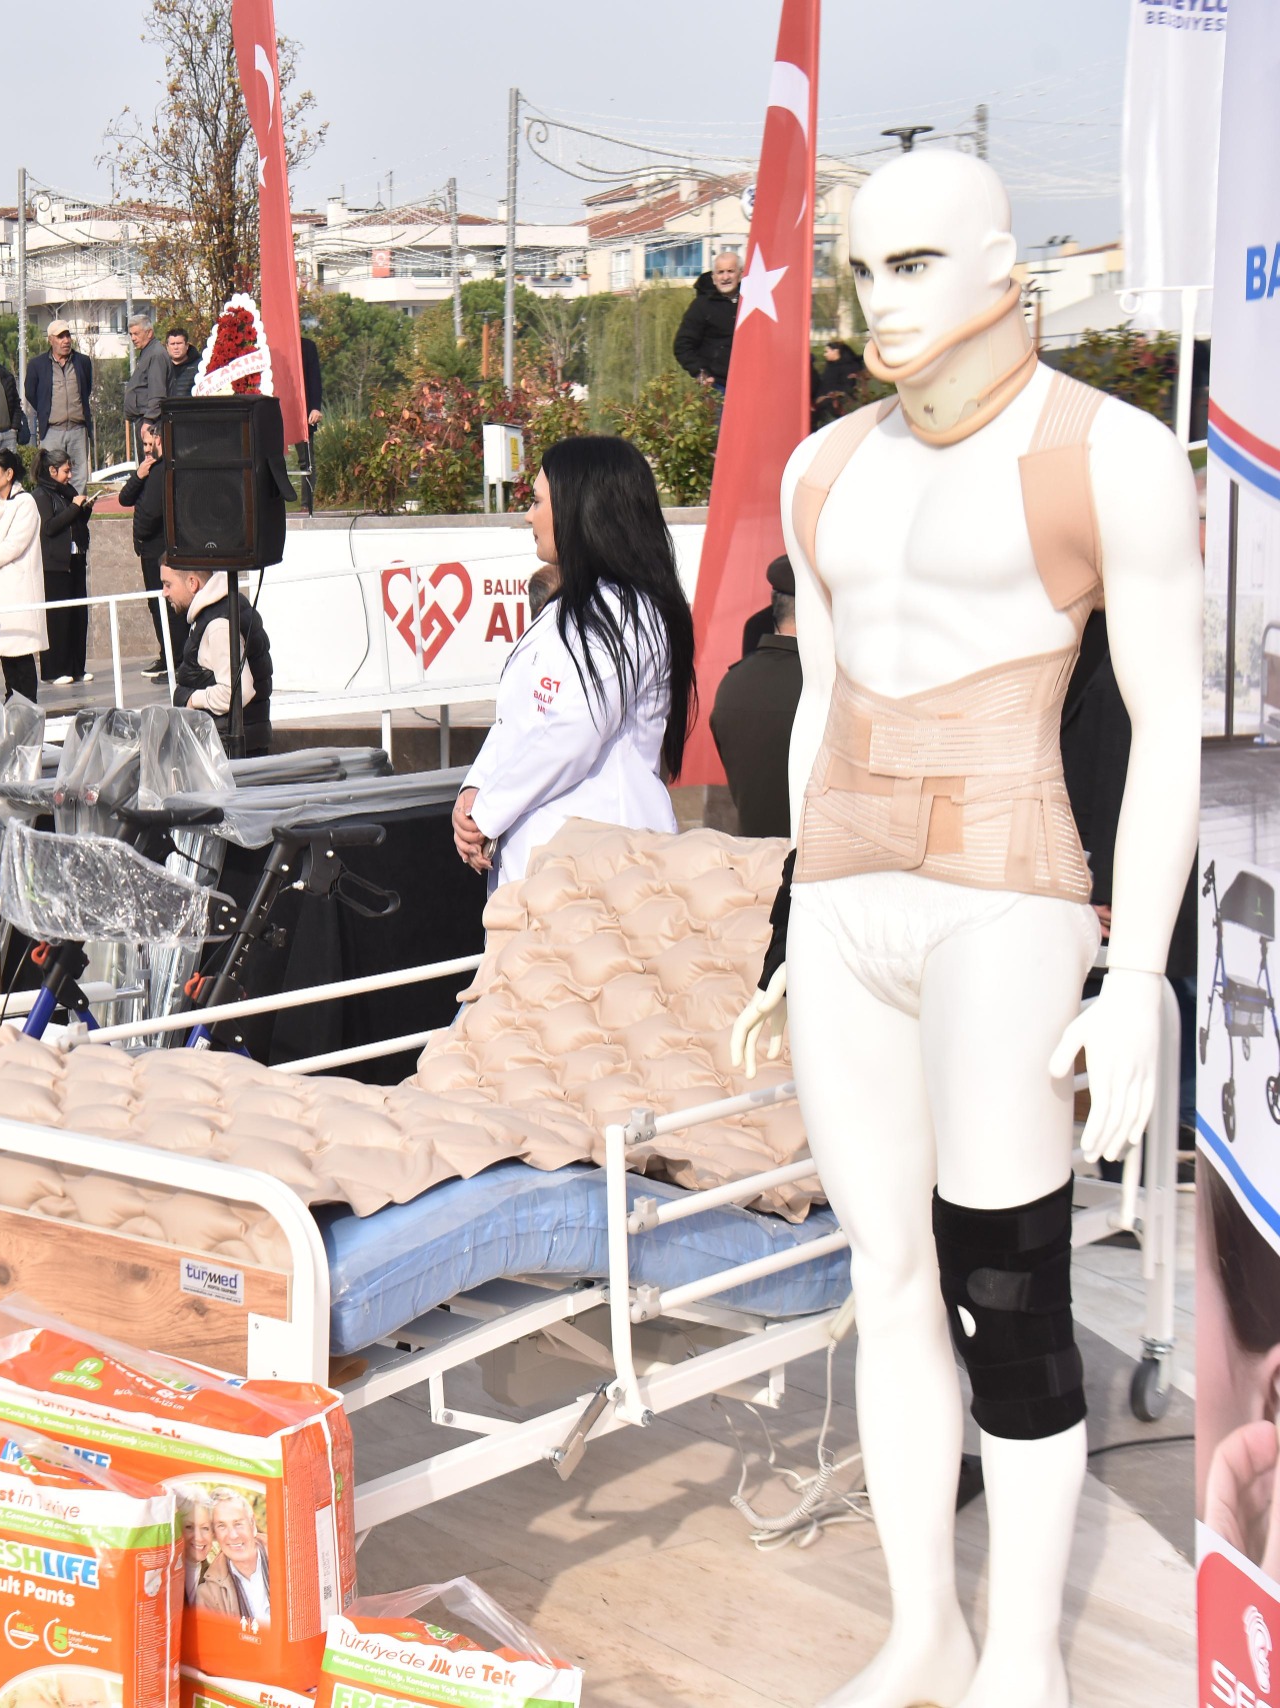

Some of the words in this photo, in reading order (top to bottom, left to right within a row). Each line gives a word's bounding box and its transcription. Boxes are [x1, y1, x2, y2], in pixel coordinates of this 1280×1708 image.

[484, 579, 528, 596] BALIK
[17, 1491, 33, 1507] in
[23, 1582, 76, 1608] Pants
[53, 1626, 68, 1650] 5
[339, 1628, 425, 1669] Türkiye'de
[455, 1665, 476, 1680] ve
[482, 1664, 517, 1688] Tek
